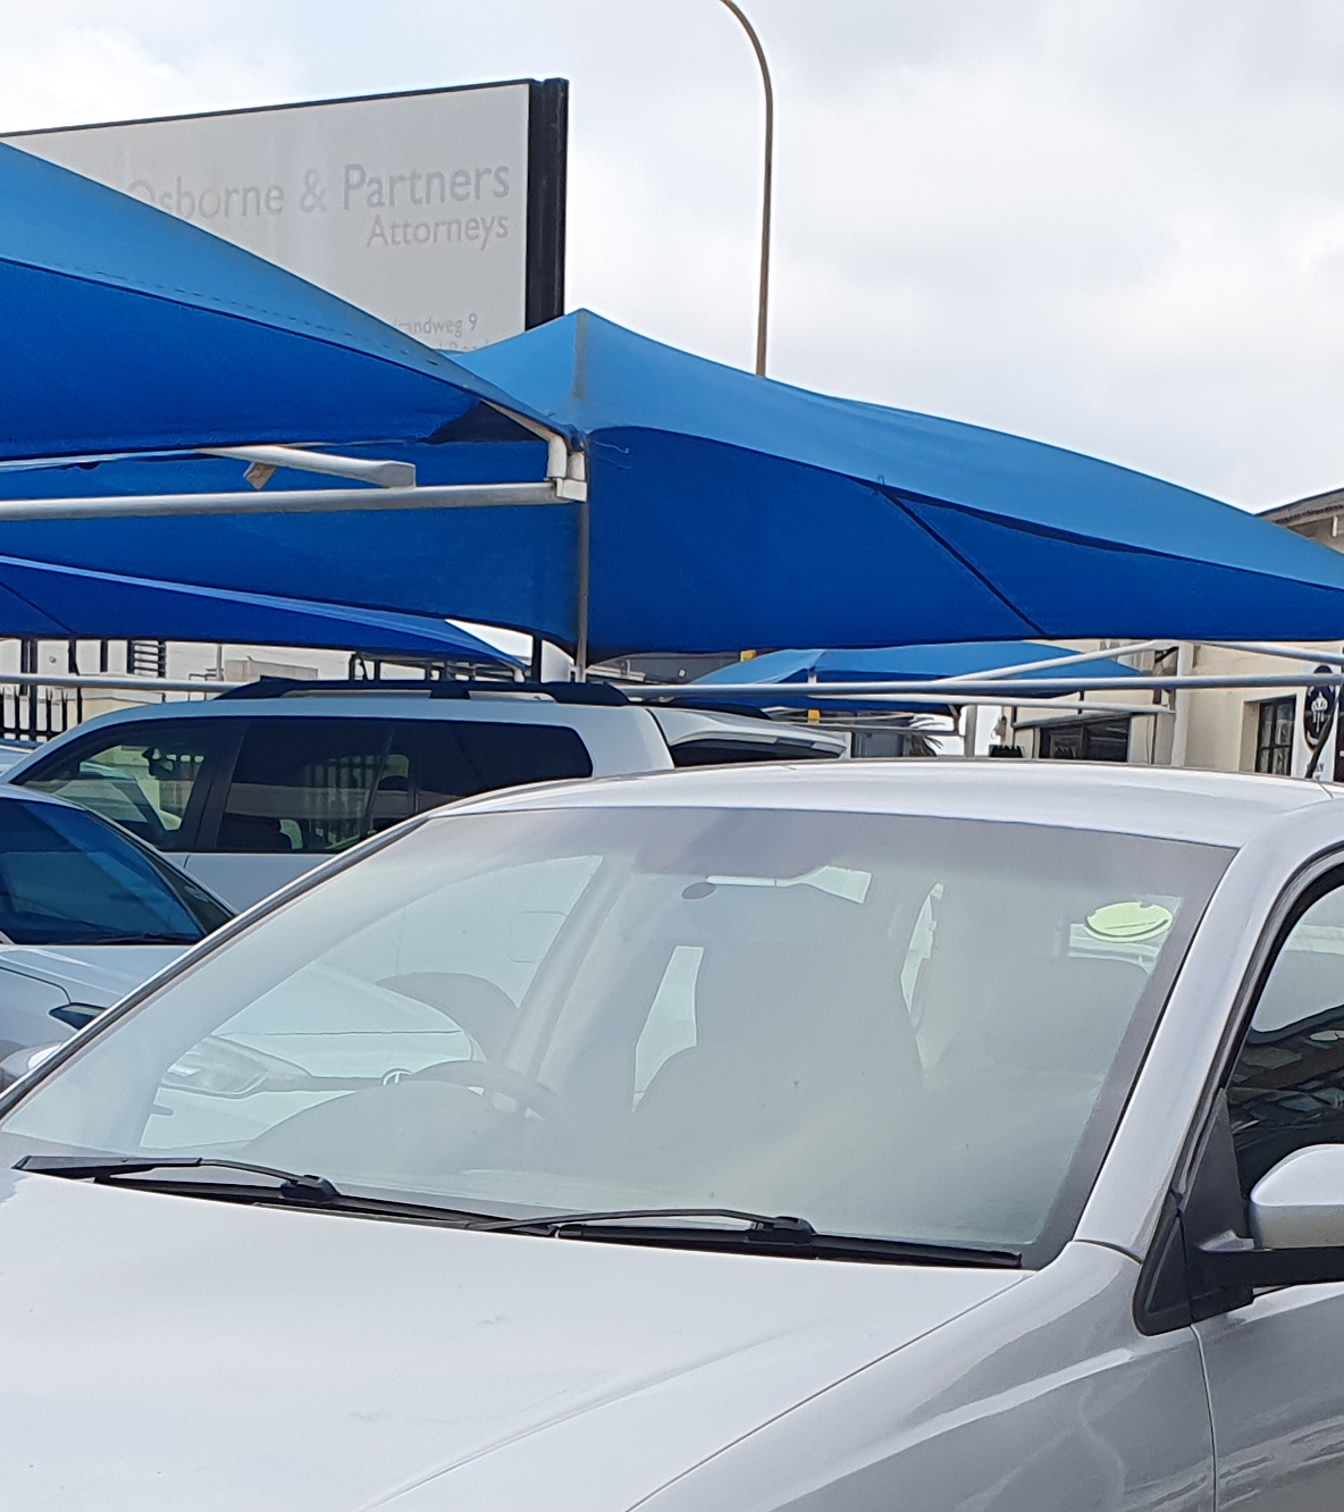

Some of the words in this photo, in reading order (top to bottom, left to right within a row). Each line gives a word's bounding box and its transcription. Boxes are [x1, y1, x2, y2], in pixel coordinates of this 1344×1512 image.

[299, 167, 328, 214] &
[343, 162, 512, 212] Partners
[366, 213, 510, 252] Attorneys
[468, 312, 479, 332] 9
